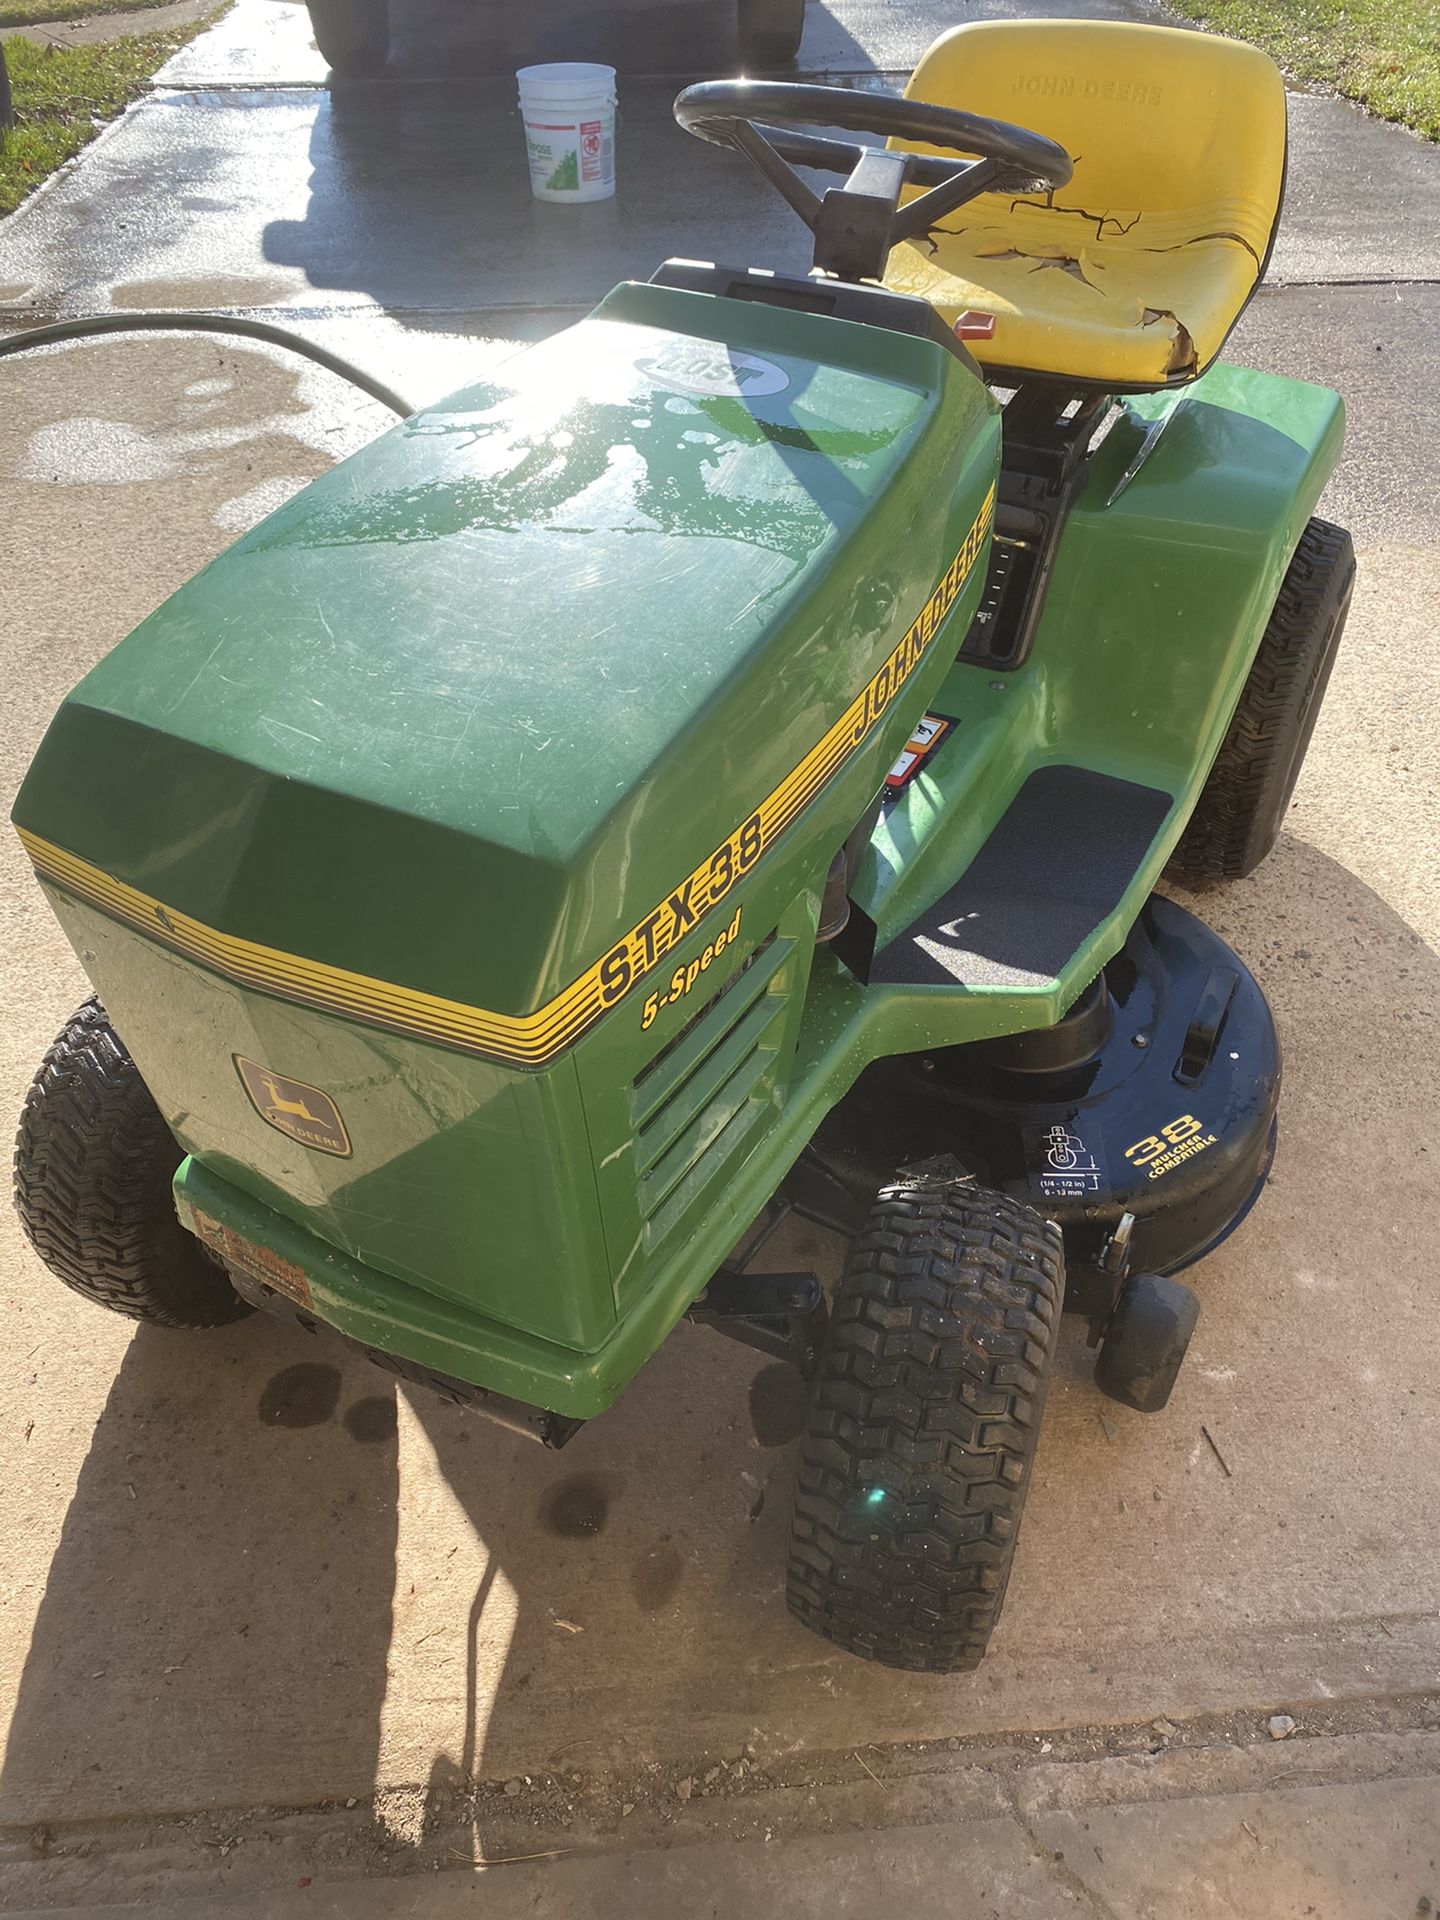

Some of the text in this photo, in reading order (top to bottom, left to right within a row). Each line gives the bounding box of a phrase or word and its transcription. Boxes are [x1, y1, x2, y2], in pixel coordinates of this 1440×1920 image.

[1009, 74, 1163, 106] JOHN DEERE
[854, 511, 983, 741] JOHN DEERE
[600, 813, 762, 1004] STX 38
[641, 905, 742, 1031] 5-Speed
[297, 1127, 342, 1149] DEERE
[1125, 1114, 1203, 1166] 38
[1148, 1134, 1216, 1179] COMPATIBLE
[1150, 1134, 1203, 1169] MULCHER
[1040, 1180, 1055, 1188] (1/4
[1074, 1180, 1085, 1189] in)
